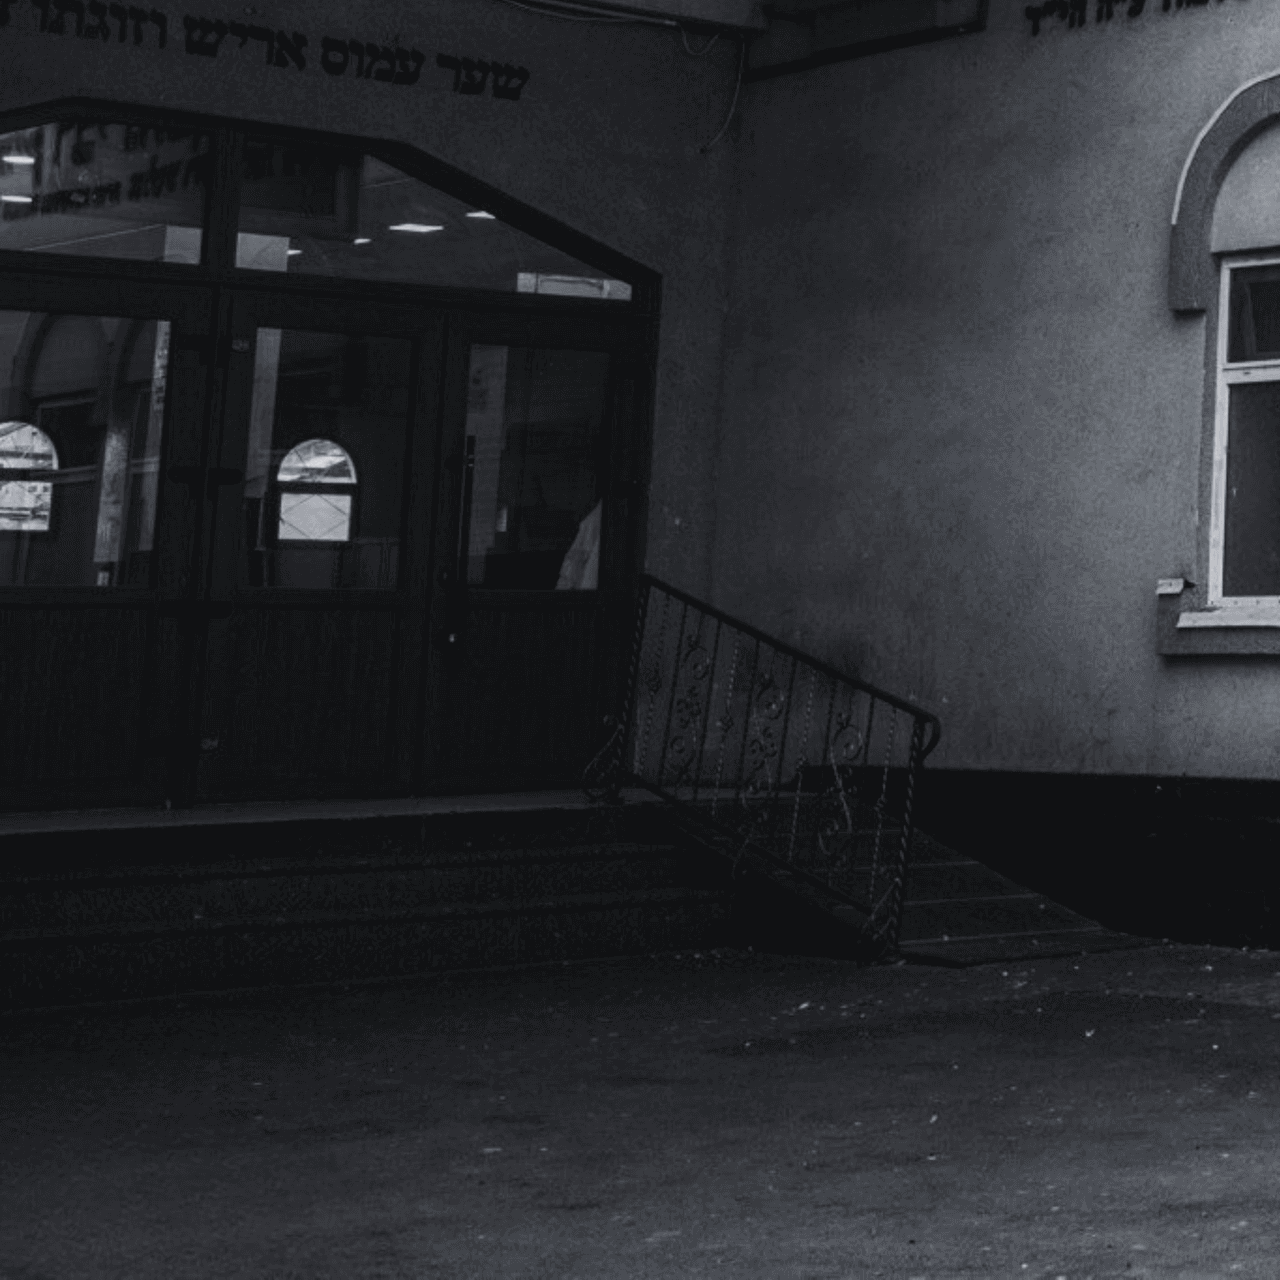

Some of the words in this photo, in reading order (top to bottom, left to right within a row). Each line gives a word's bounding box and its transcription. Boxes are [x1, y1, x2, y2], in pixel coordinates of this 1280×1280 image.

[183, 14, 308, 71] אריש
[320, 34, 426, 86] עמוס
[436, 53, 530, 101] שער
